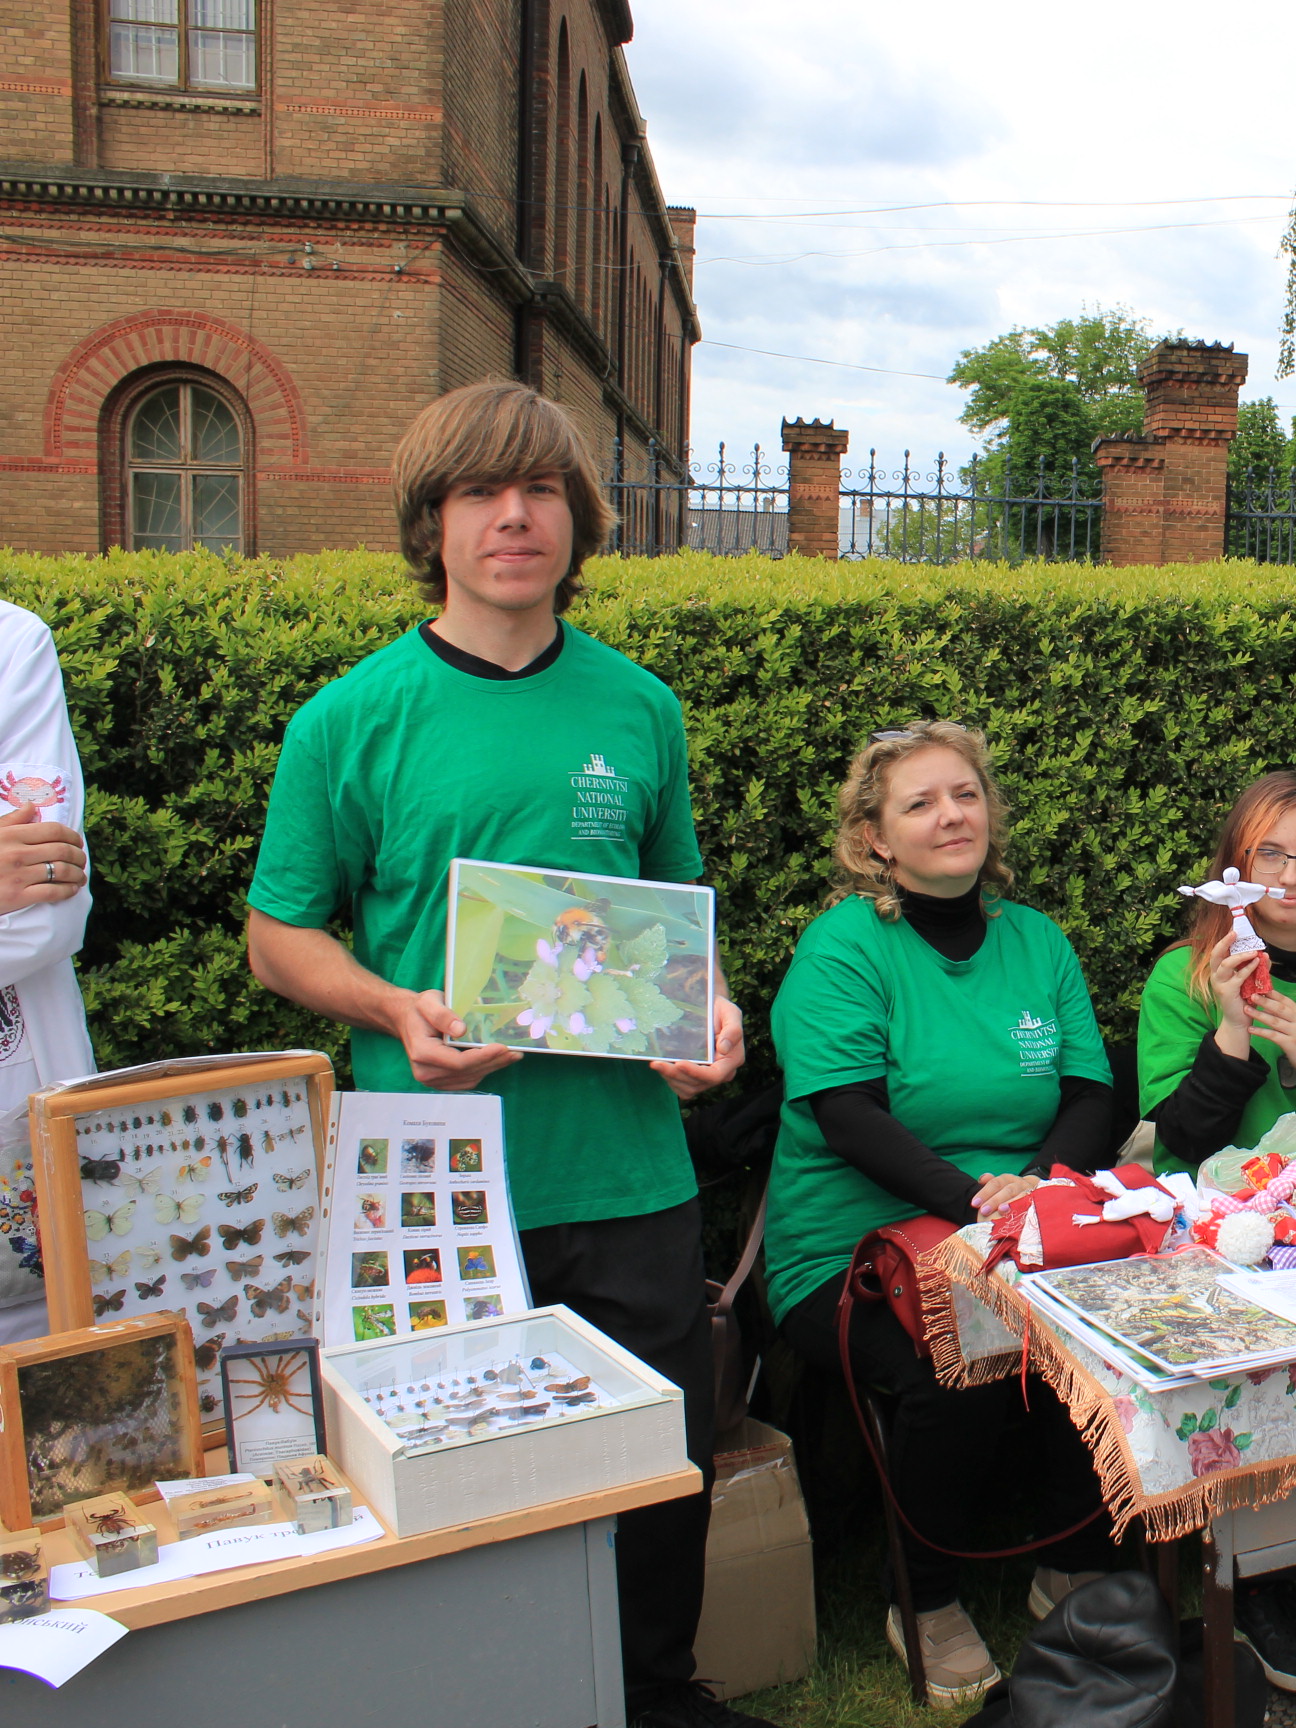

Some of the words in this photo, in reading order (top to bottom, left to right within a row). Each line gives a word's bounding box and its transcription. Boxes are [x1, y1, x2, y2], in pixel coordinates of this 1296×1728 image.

[570, 776, 628, 792] CHERNIVTSI
[577, 791, 624, 806] NATIONAL
[1010, 1023, 1057, 1040] CHERNIVTSI
[1018, 1037, 1056, 1049] NATIONAL
[206, 1532, 265, 1549] Павук
